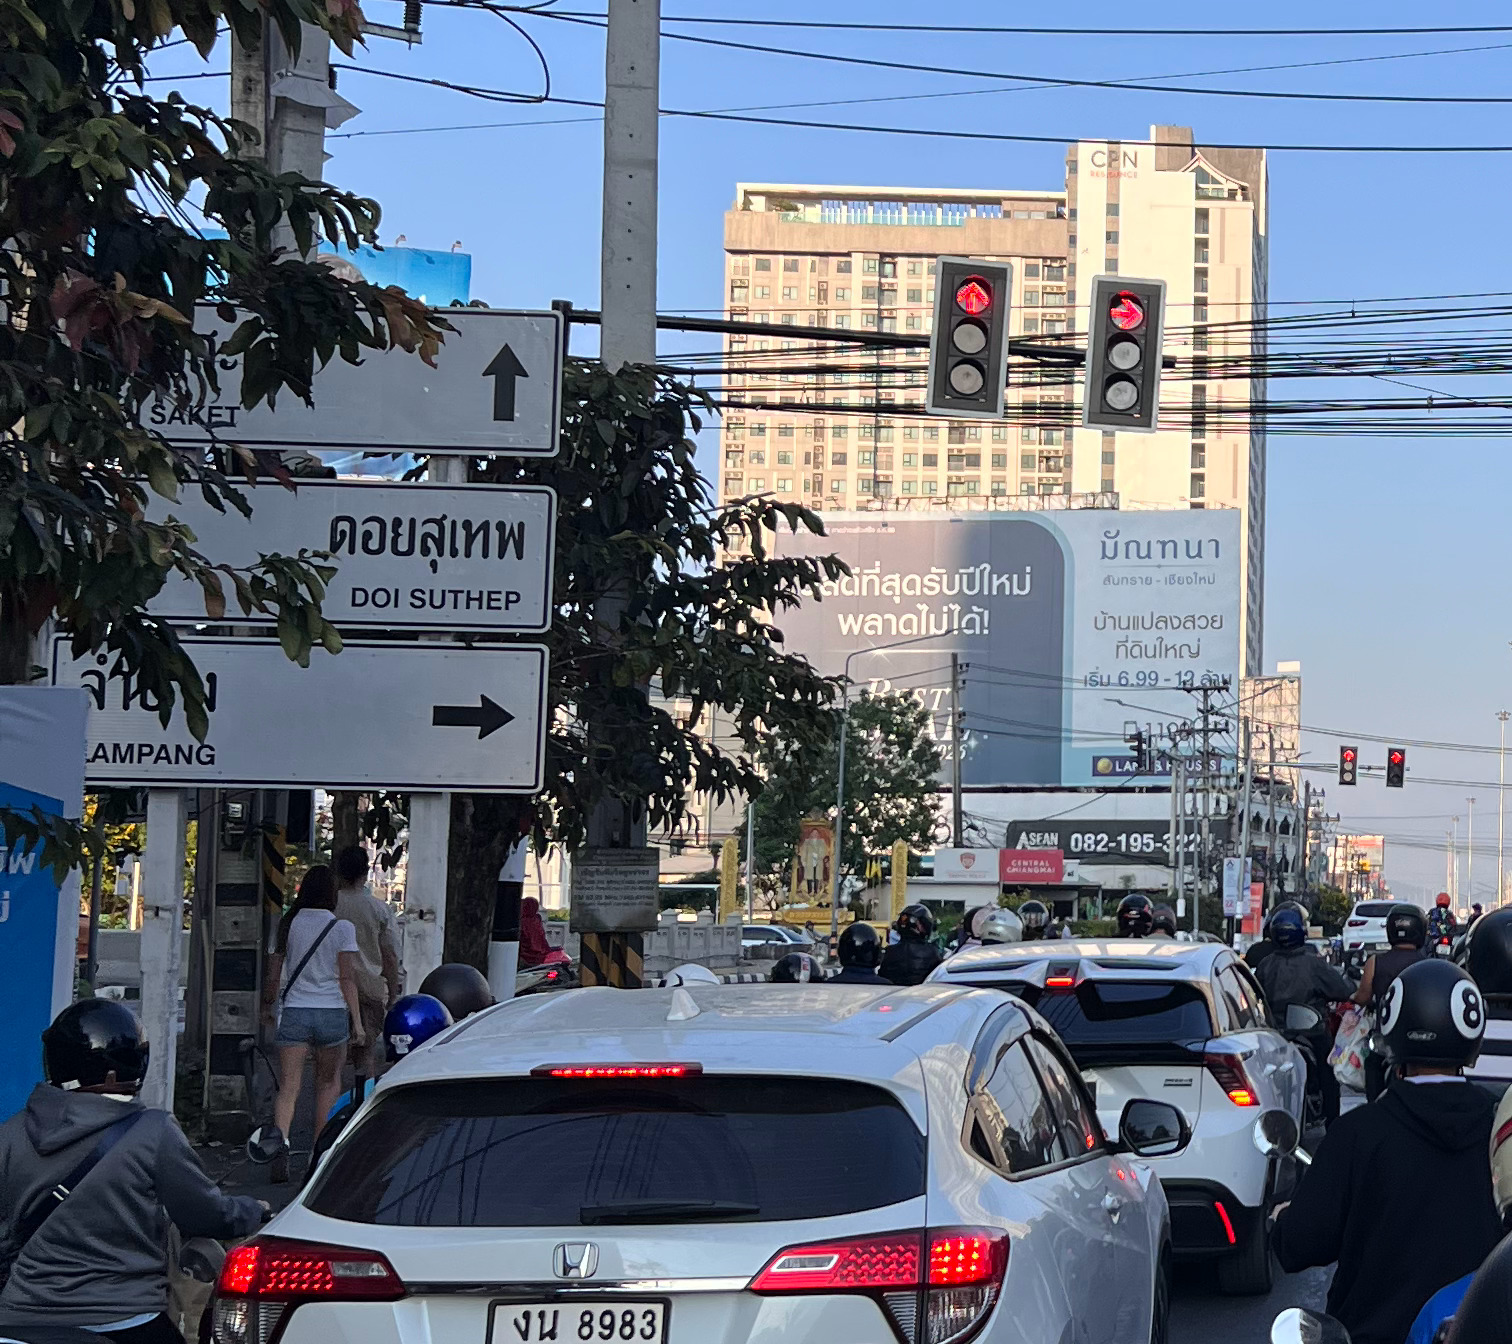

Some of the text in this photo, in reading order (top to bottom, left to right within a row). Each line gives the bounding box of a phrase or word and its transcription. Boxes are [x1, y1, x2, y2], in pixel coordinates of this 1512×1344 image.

[1091, 150, 1138, 168] CPN
[329, 514, 525, 573] ดอยสุเทพ
[1165, 571, 1216, 586] เชียงใหม่
[351, 587, 521, 610] DOI SUTHEP
[1094, 611, 1223, 631] บ้านแปลงสวย
[1115, 635, 1200, 659] ที่ดินใหญ่
[1118, 670, 1158, 687] 6.99
[87, 743, 216, 765] AMPANG
[1016, 831, 1059, 849] ASEAN
[1462, 987, 1480, 1029] 8
[513, 1309, 656, 1342] งน 8983
